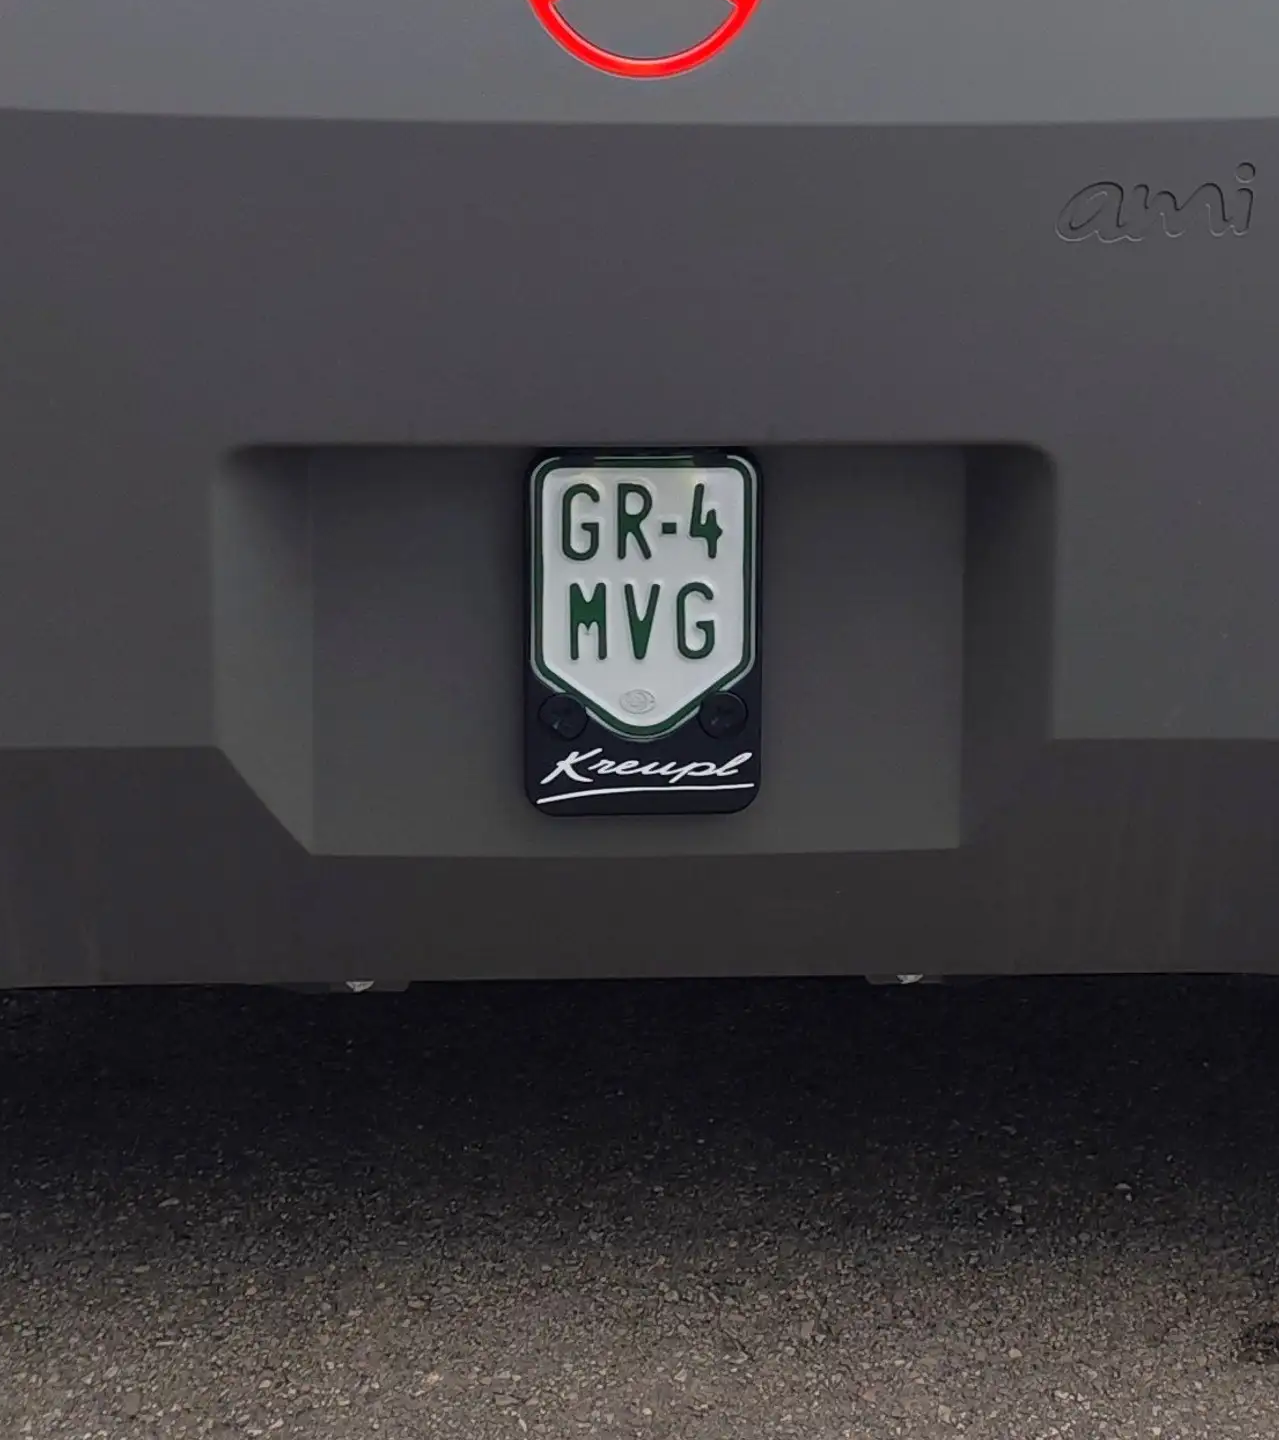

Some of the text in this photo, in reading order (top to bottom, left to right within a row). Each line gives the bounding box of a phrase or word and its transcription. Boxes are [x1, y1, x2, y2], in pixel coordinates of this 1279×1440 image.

[1055, 162, 1257, 244] ami
[561, 482, 724, 562] GR-4
[569, 580, 717, 661] MVG
[540, 747, 753, 785] Kreupl
